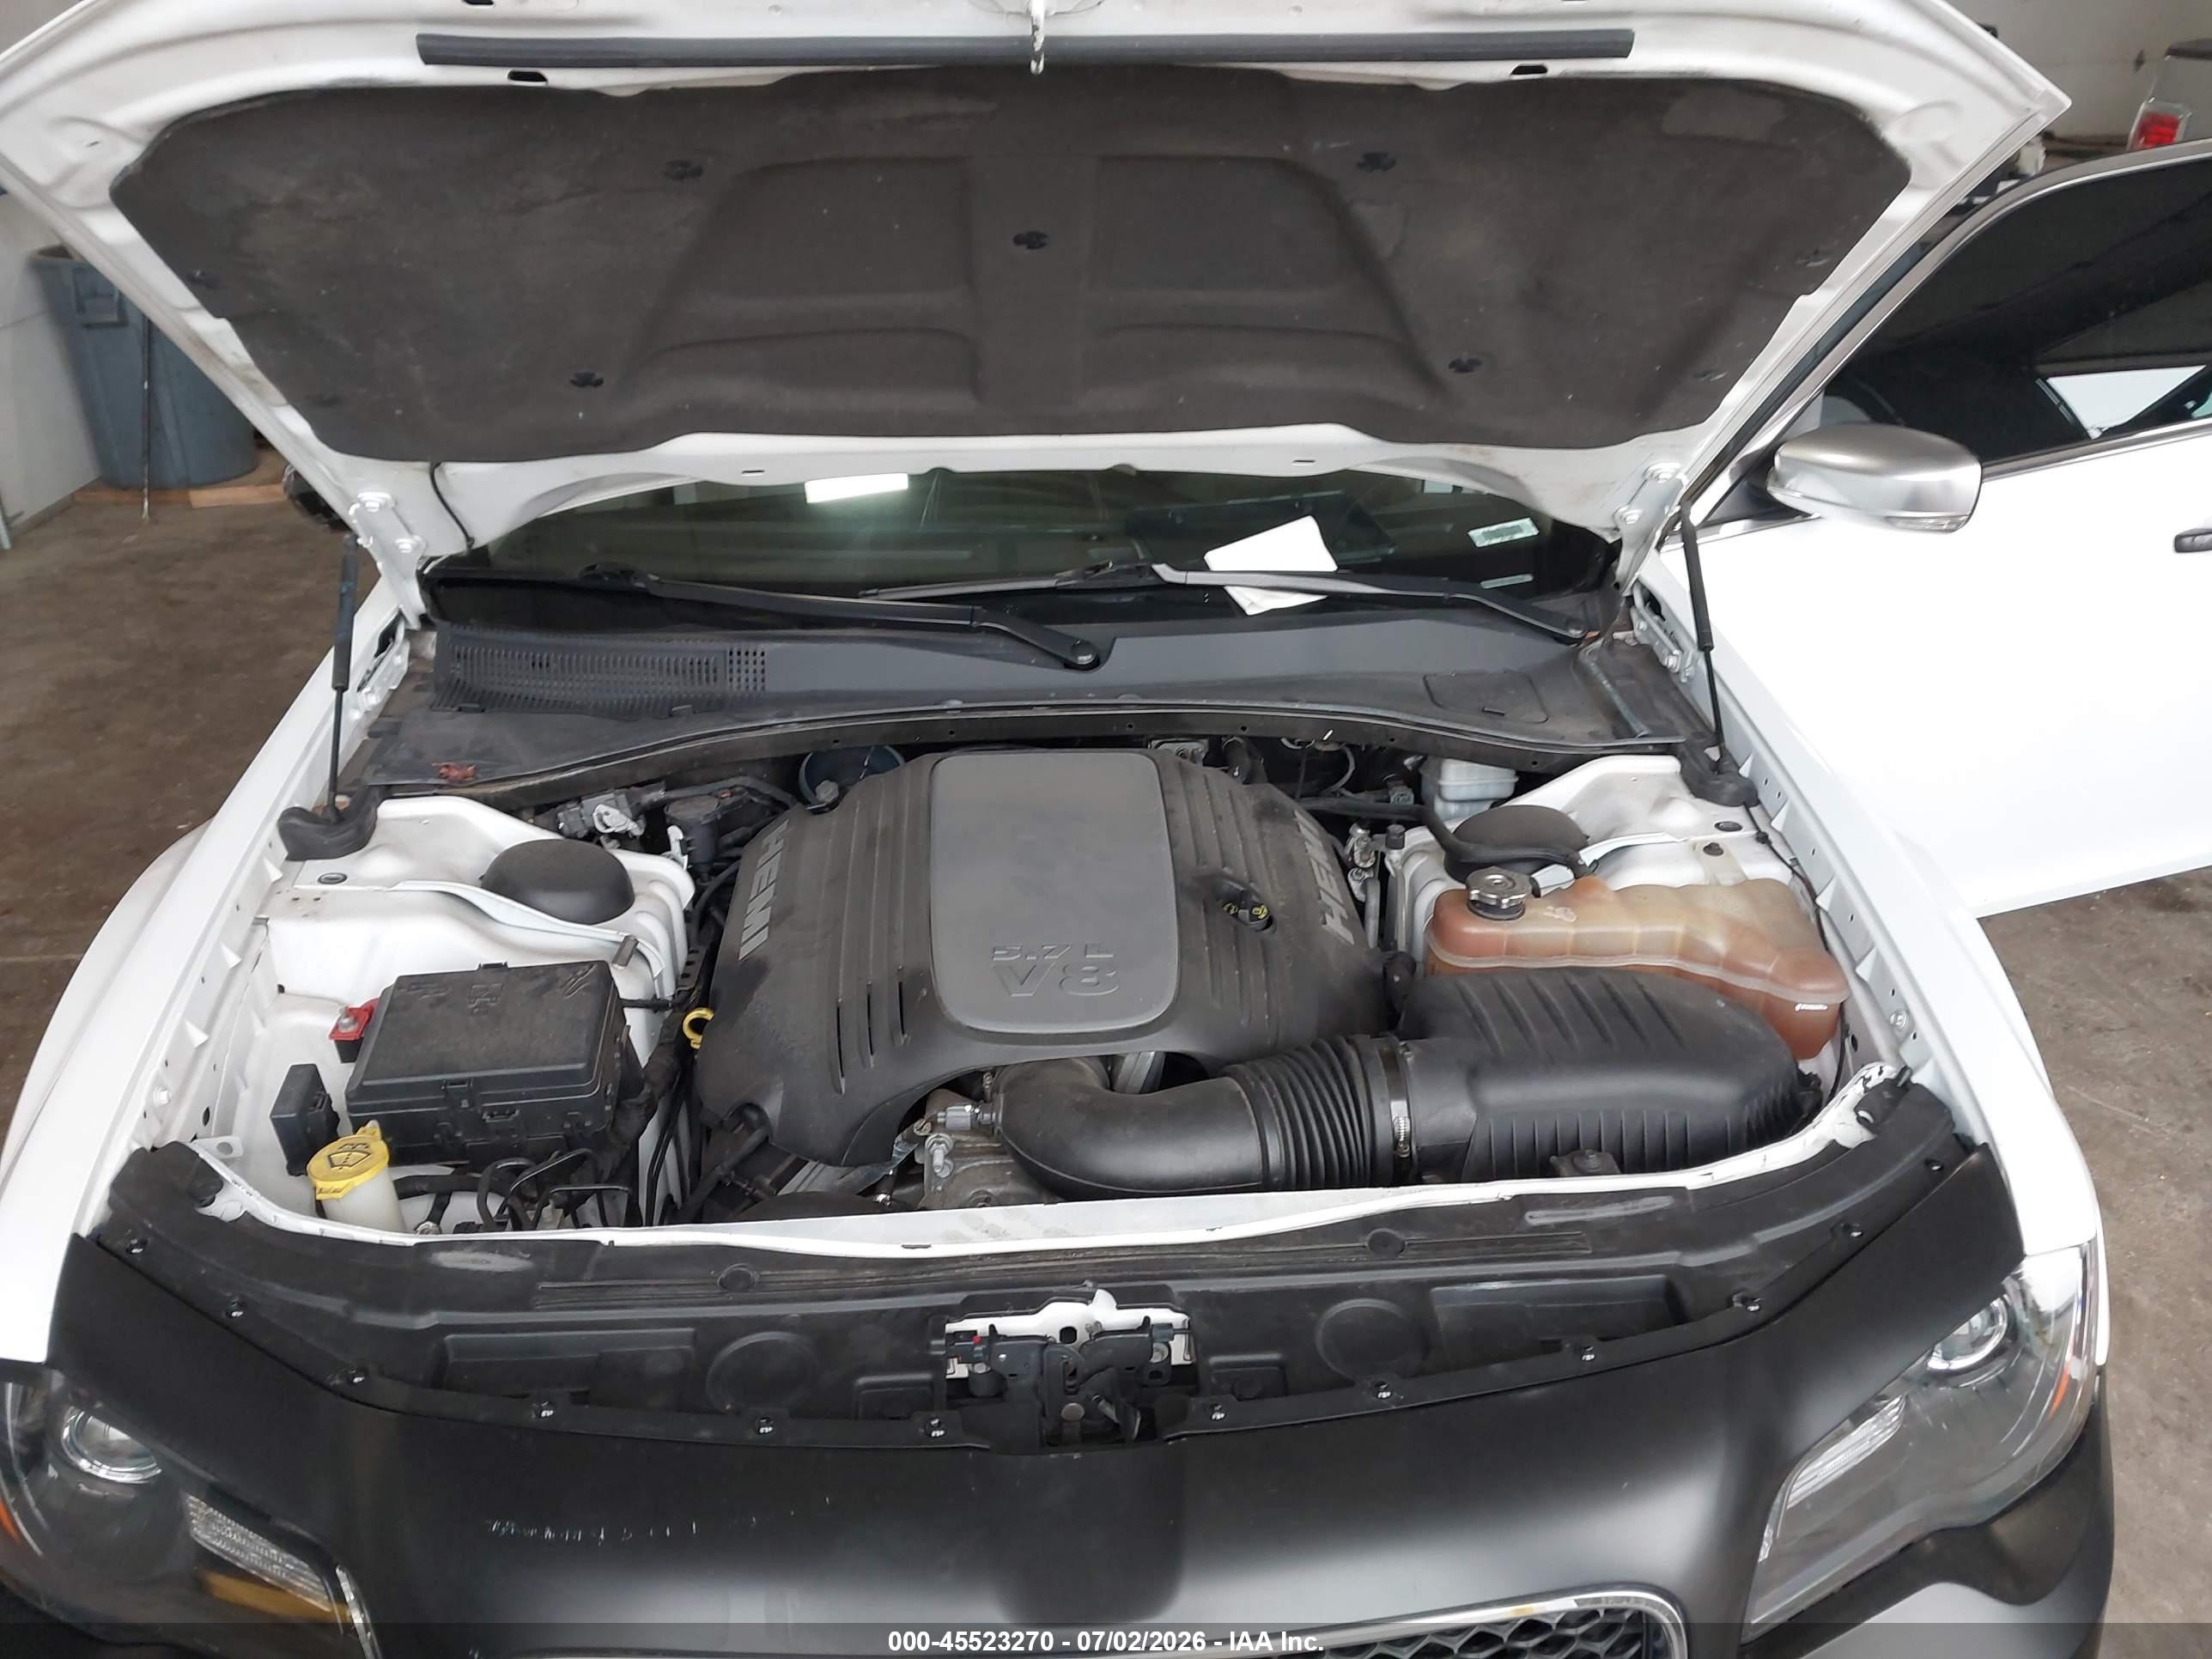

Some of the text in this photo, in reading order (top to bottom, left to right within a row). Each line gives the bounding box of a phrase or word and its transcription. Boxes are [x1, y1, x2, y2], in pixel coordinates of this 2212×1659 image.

[738, 819, 789, 961] HEMI
[1293, 809, 1355, 945] HEMI
[991, 963, 1120, 996] V8
